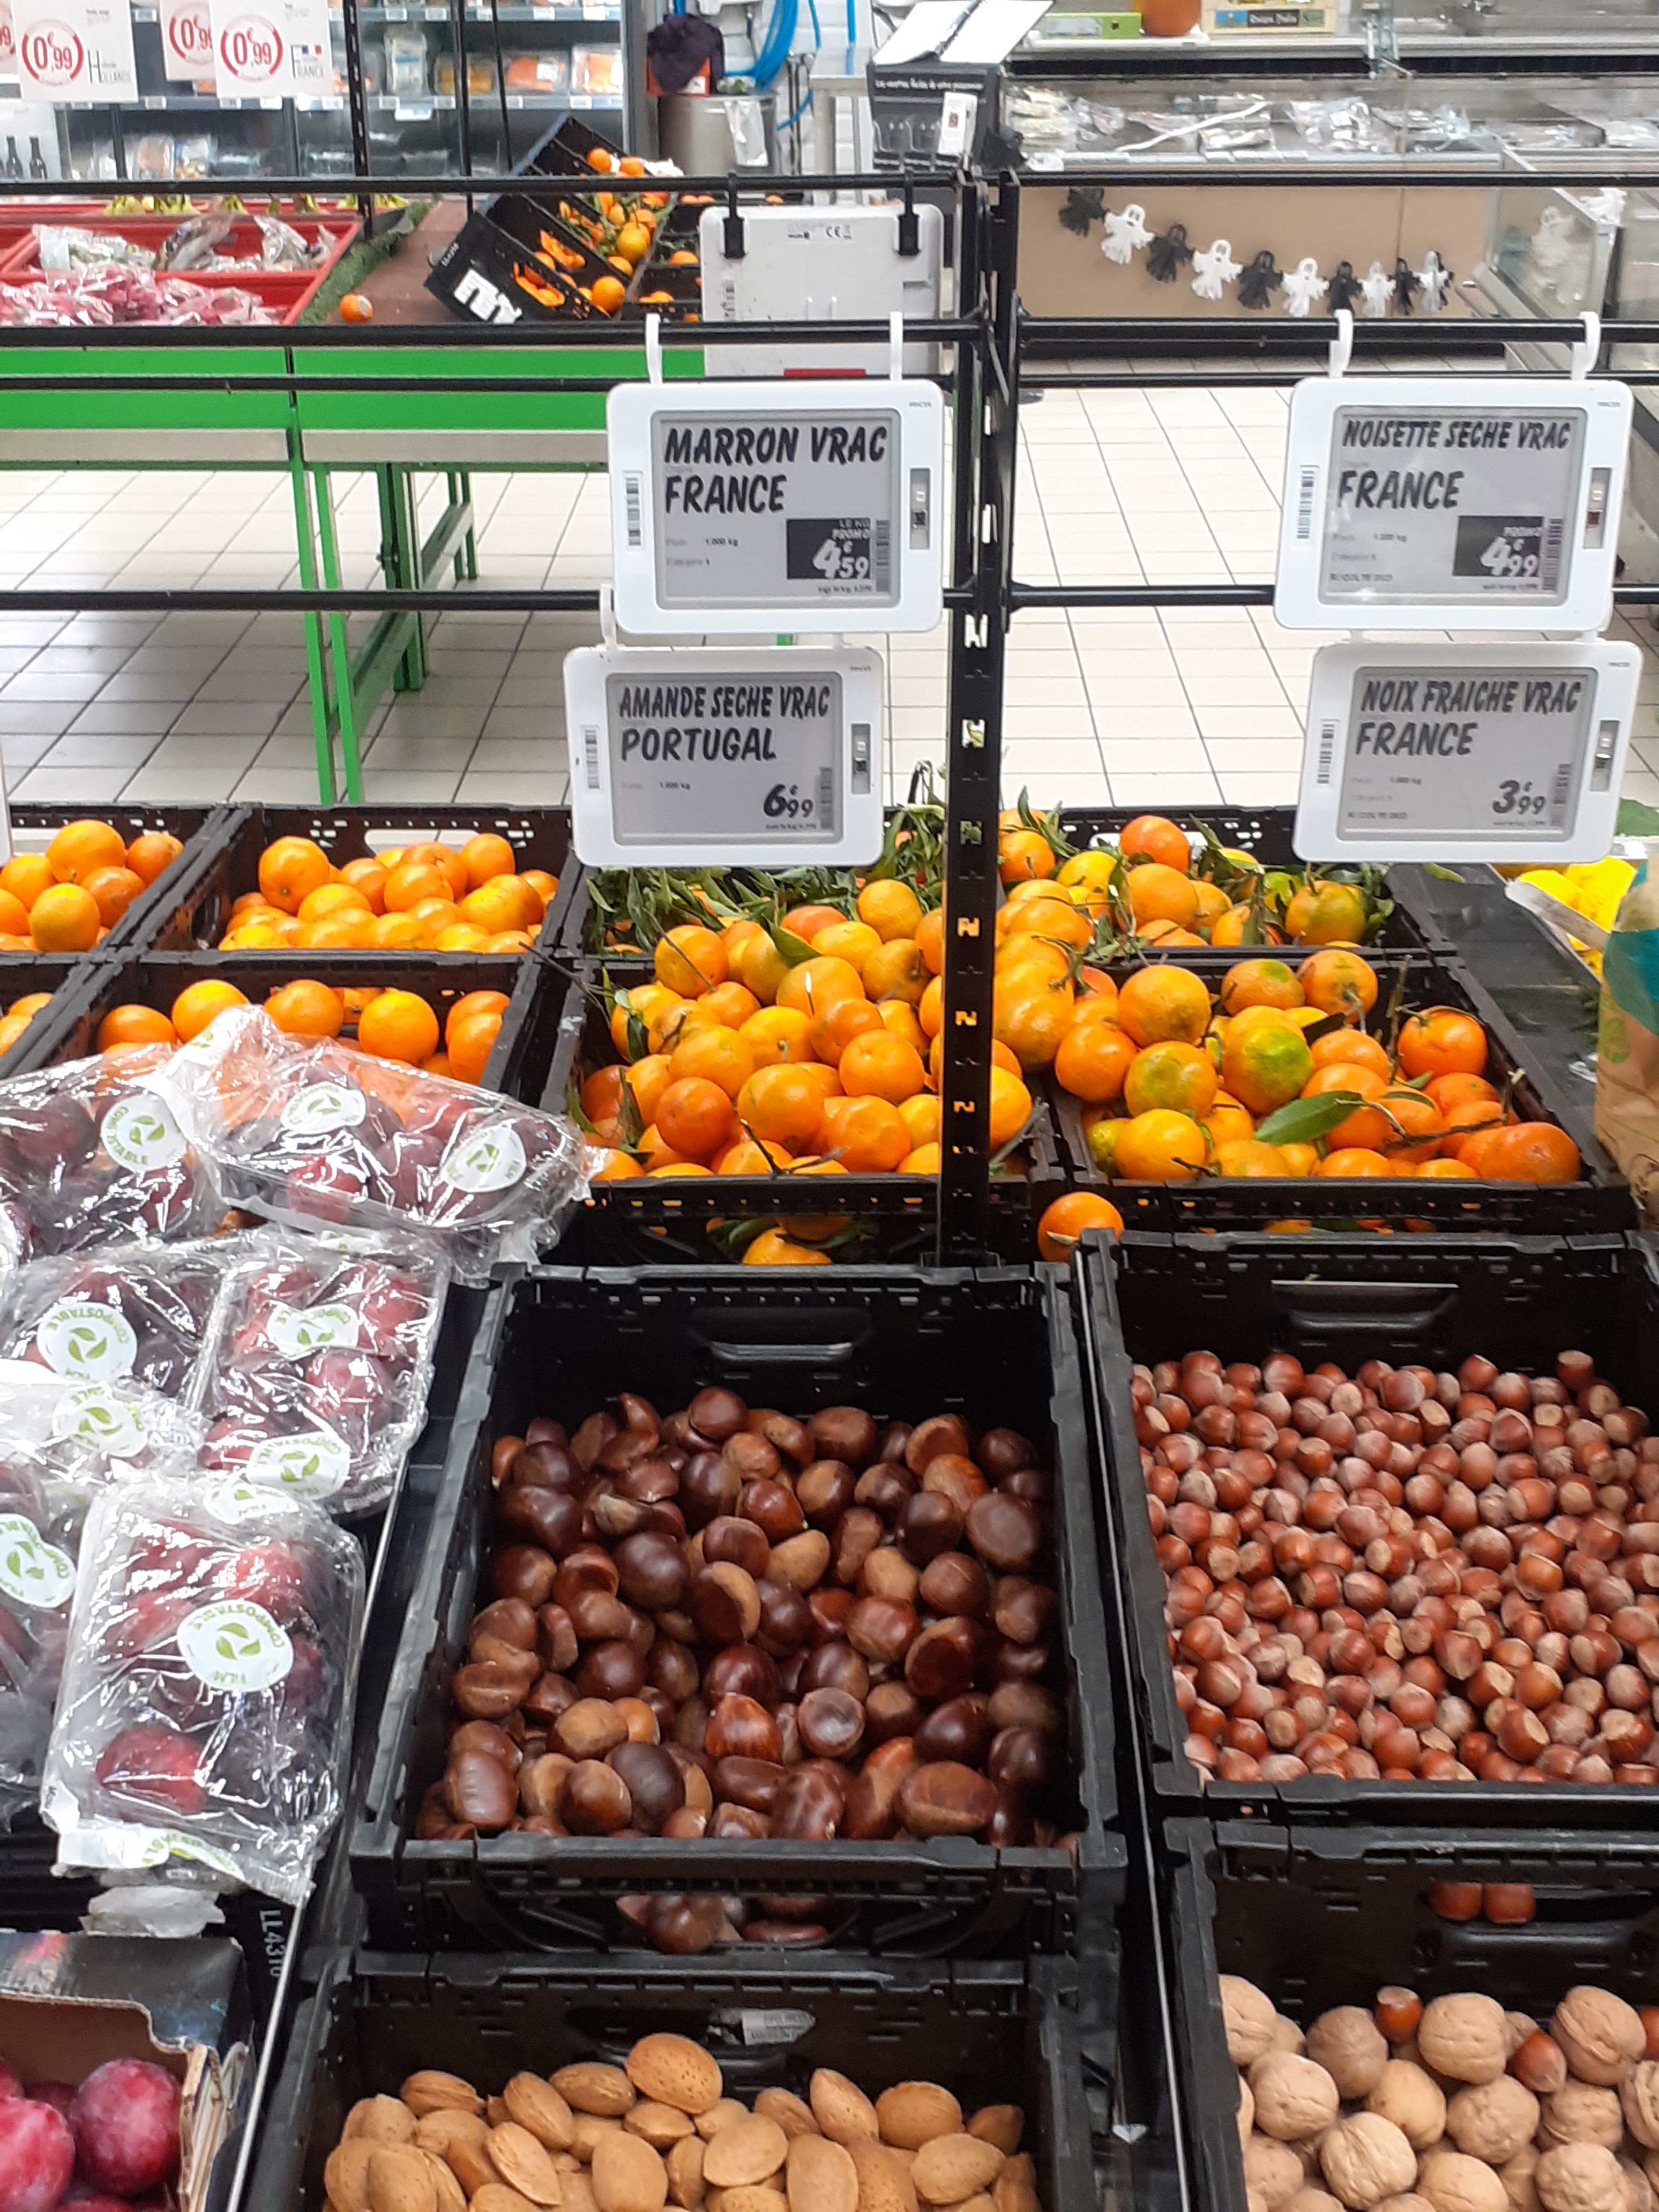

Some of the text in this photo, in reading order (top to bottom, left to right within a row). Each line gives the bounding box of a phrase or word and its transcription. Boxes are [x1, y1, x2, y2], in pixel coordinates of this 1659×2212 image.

[664, 426, 888, 466] MARRON VRAC
[1342, 420, 1571, 451] NOISETTE SECHE VRAC
[665, 474, 788, 514] FRANCE
[1337, 470, 1466, 510] FRANCE
[619, 685, 831, 720] AMANDE SECHE VRAC
[1361, 680, 1582, 715] NOIX FRAICHE VRAC
[621, 727, 777, 762] PORTUGAL
[1356, 721, 1479, 757] FRANCE
[189, 1604, 286, 1648] COMPOSTABLE
